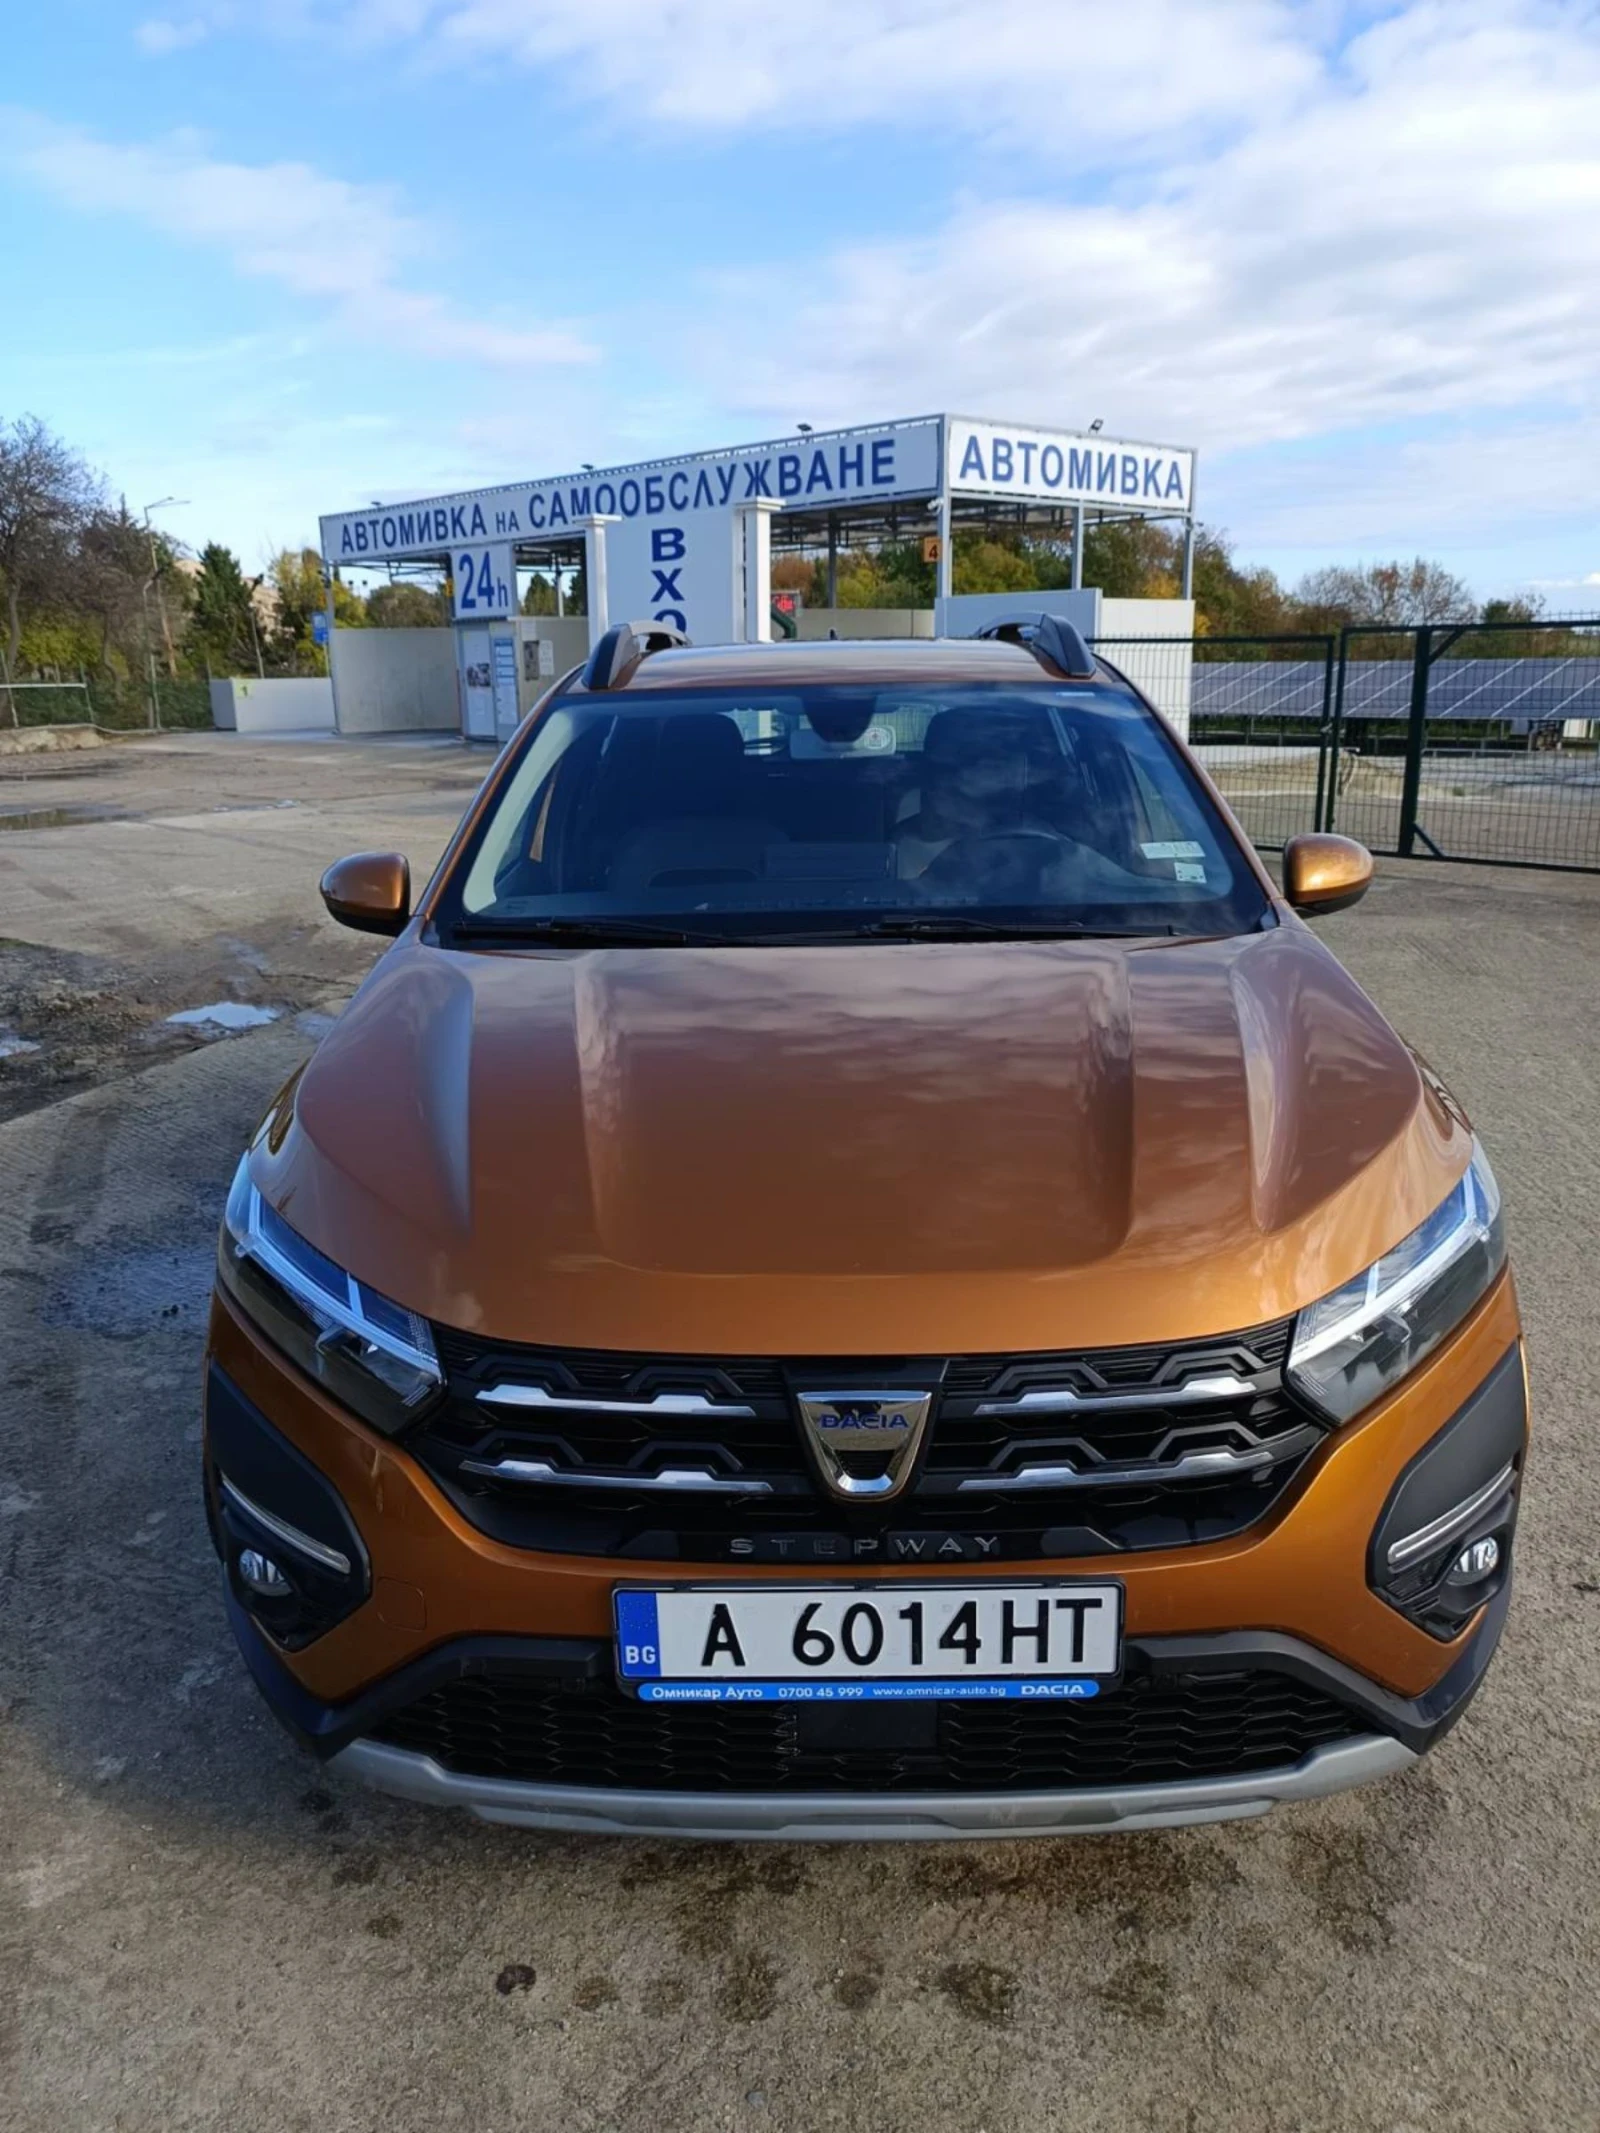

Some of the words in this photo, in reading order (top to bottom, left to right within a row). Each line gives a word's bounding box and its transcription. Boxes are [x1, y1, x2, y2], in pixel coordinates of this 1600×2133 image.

[959, 434, 1184, 500] АВТОМИВКА
[340, 503, 487, 554] АВТОМИВКА
[495, 511, 520, 533] НА
[528, 439, 896, 528] САМООБСЛУЖВАНЕ
[820, 1413, 909, 1429] DACIA
[729, 1537, 999, 1555] STEPWAY
[625, 1646, 656, 1665] BG
[652, 1687, 721, 1700] Омникар
[725, 1686, 763, 1700] Ауто
[778, 1687, 814, 1698] 0700
[816, 1687, 834, 1697] 45
[838, 1687, 863, 1697] 999
[873, 1685, 1006, 1697] www.omnicar-auto.bg
[1021, 1684, 1085, 1695] DACIA
